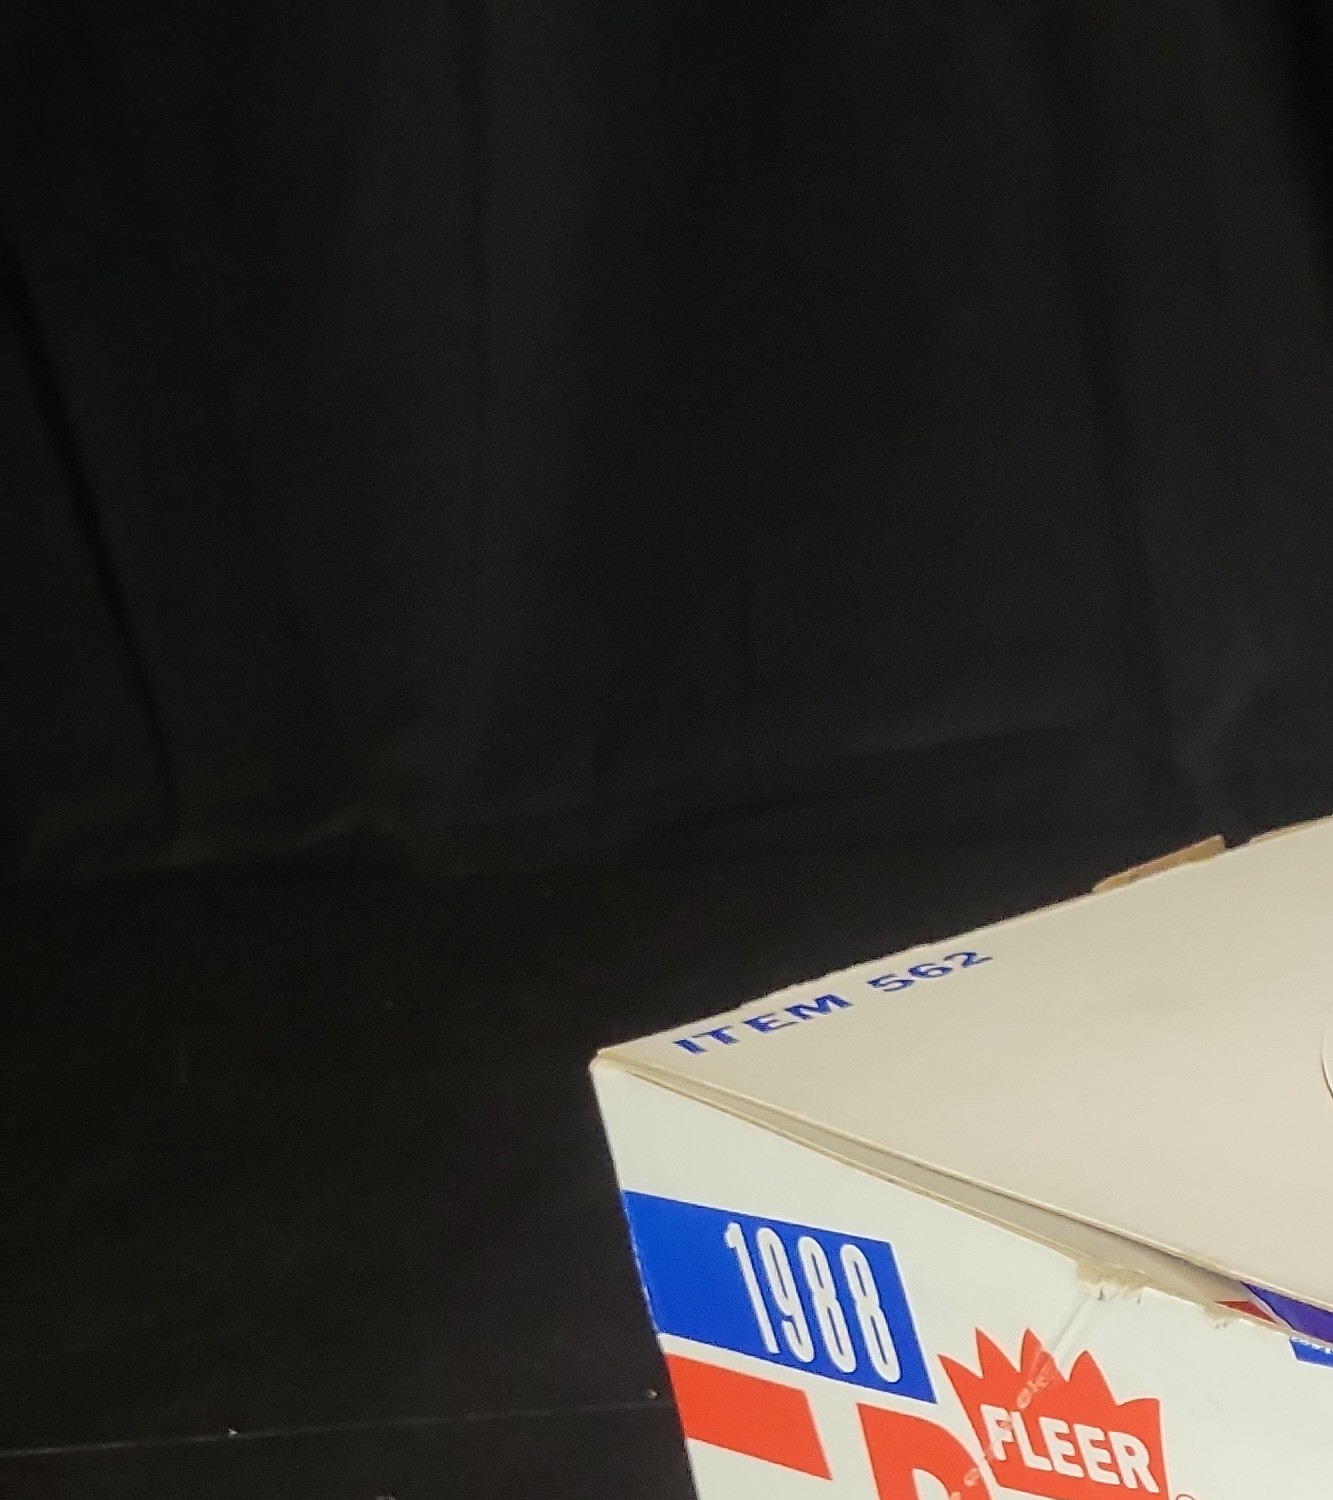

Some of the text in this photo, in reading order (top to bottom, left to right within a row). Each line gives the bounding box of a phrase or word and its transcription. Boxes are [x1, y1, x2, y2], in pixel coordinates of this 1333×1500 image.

[674, 951, 993, 1055] ITEM 562
[726, 1222, 900, 1383] 1988
[978, 1406, 1161, 1494] FLEER
